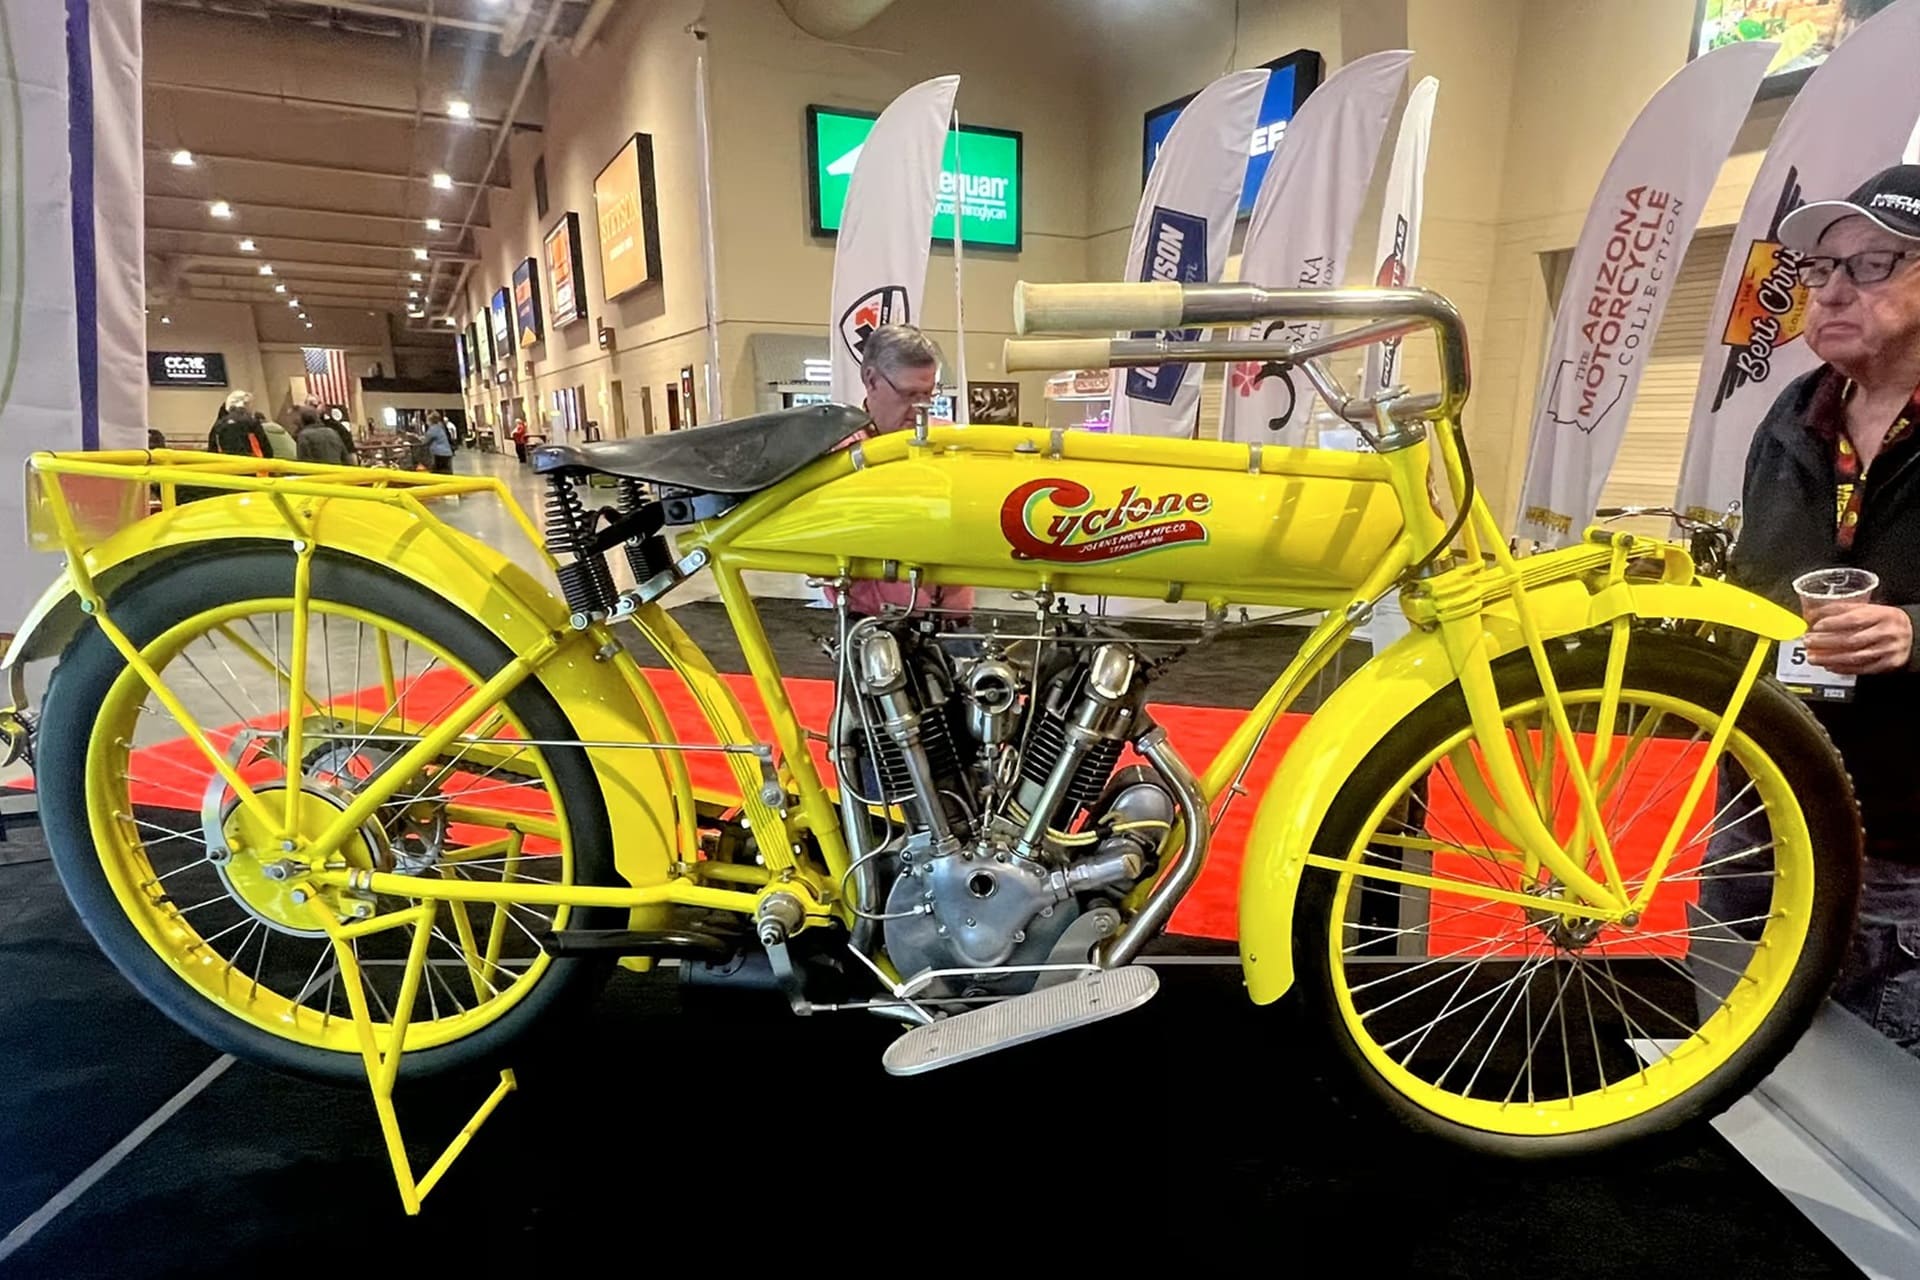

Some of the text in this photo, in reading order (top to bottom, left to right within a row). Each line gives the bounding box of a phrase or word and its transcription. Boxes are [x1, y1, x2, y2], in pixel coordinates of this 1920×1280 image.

[940, 171, 1006, 202] equan
[1250, 121, 1287, 154] EF
[1575, 185, 1647, 382] THE ARIZONA
[1578, 189, 1669, 417] MOTORCYCLE
[1618, 199, 1683, 366] COLLECTION
[1736, 249, 1804, 382] Bert Chris
[1001, 478, 1213, 560] Cyclone
